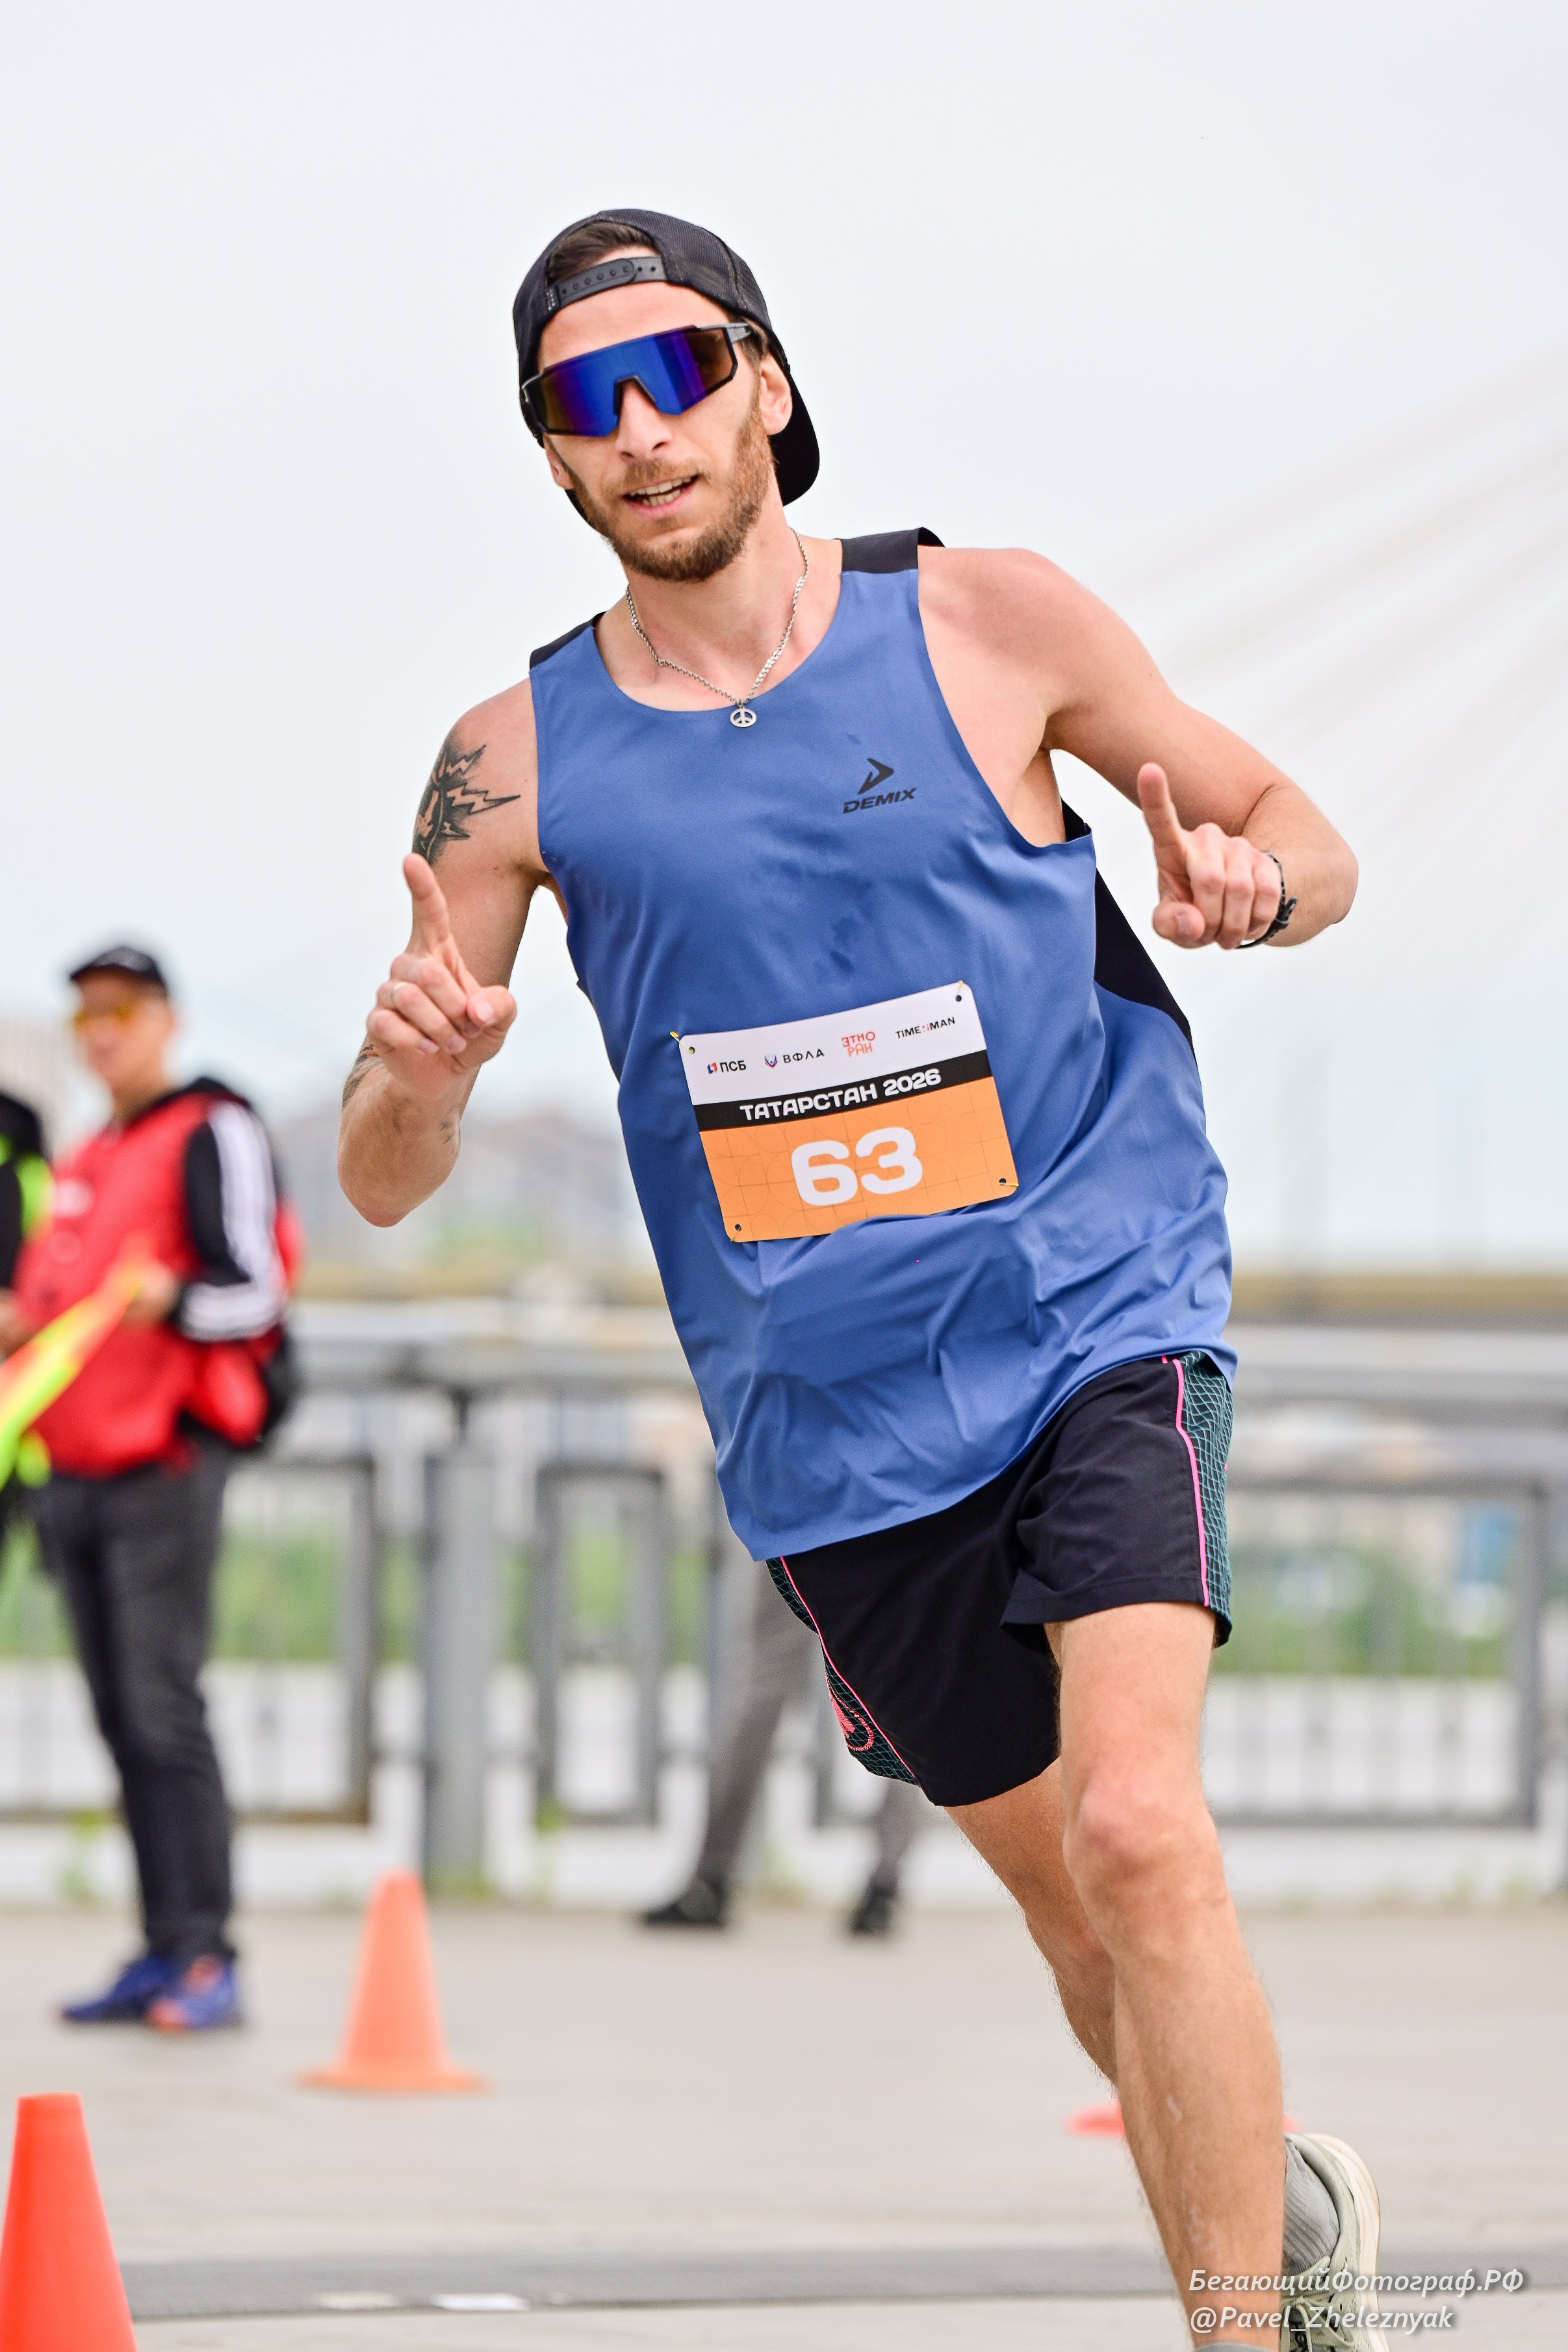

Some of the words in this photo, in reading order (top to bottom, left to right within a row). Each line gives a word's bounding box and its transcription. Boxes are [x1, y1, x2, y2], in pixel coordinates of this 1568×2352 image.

[843, 788, 917, 814] DEMIX
[841, 1031, 876, 1048] ЭТНО
[782, 1048, 825, 1064] ВФЛА
[847, 1042, 873, 1057] РАН
[719, 1059, 747, 1073] ПСБ
[739, 1083, 878, 1120] ТАТАРСТАН
[882, 1068, 942, 1096] 2026
[791, 1126, 923, 1207] 63
